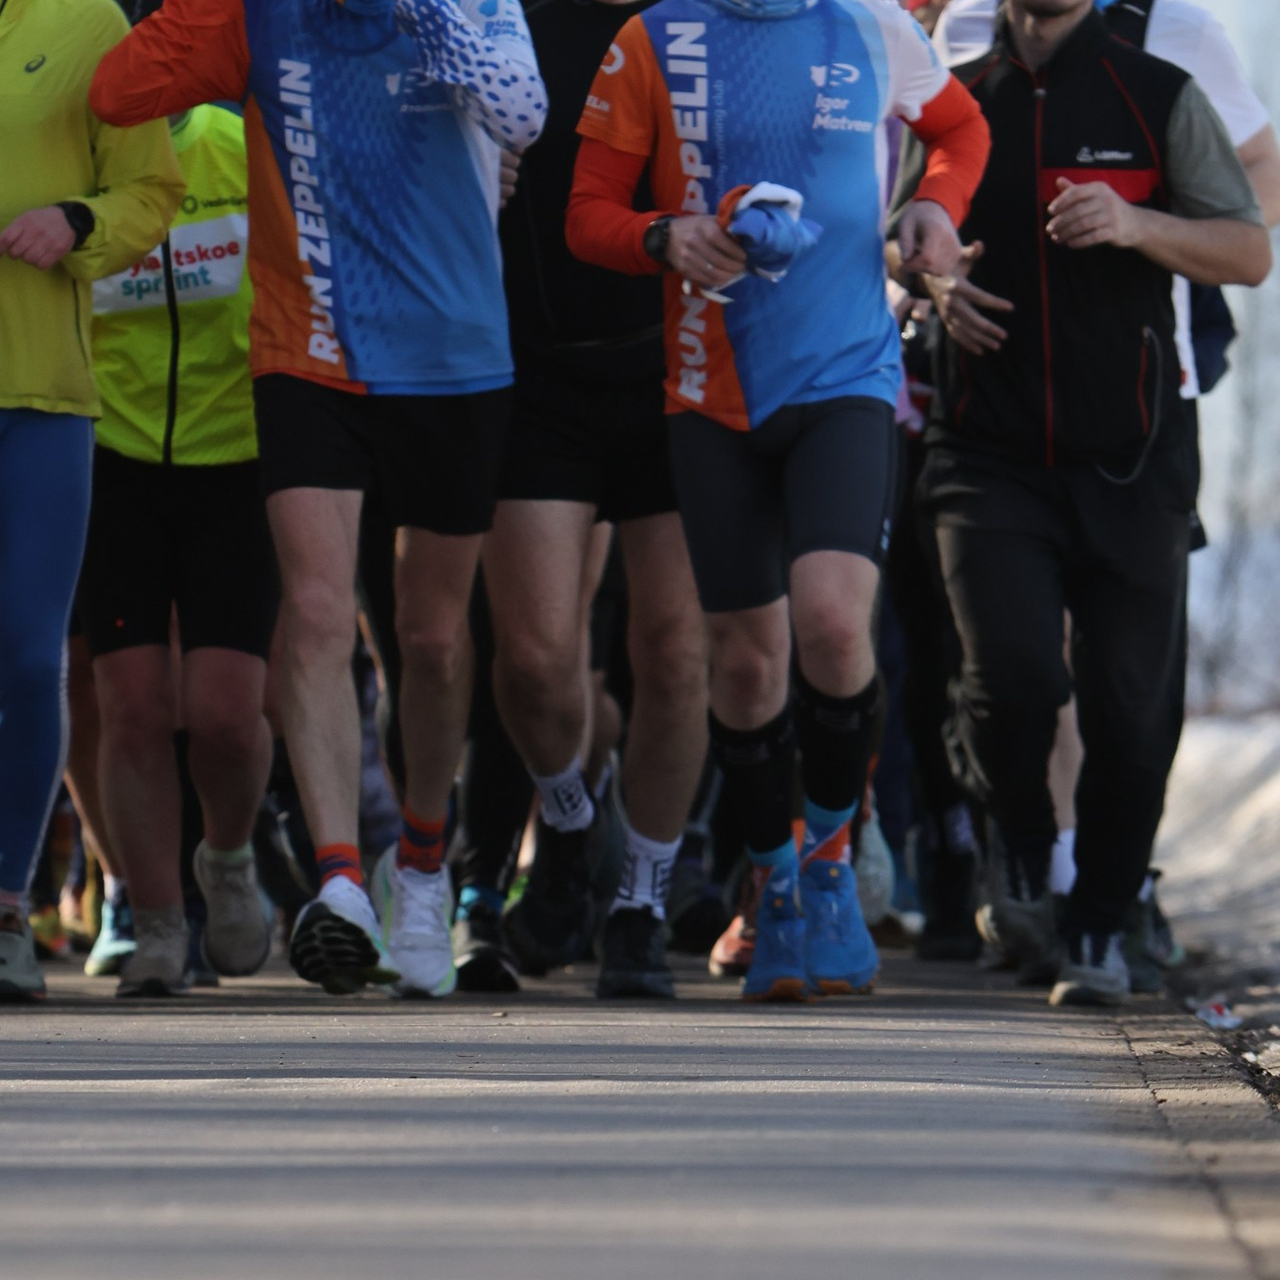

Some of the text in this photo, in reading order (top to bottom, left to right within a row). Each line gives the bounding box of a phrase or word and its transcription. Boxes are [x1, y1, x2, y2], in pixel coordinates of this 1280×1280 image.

[278, 58, 340, 366] RUN ZEPPELIN
[666, 21, 712, 405] RUN PPELIN
